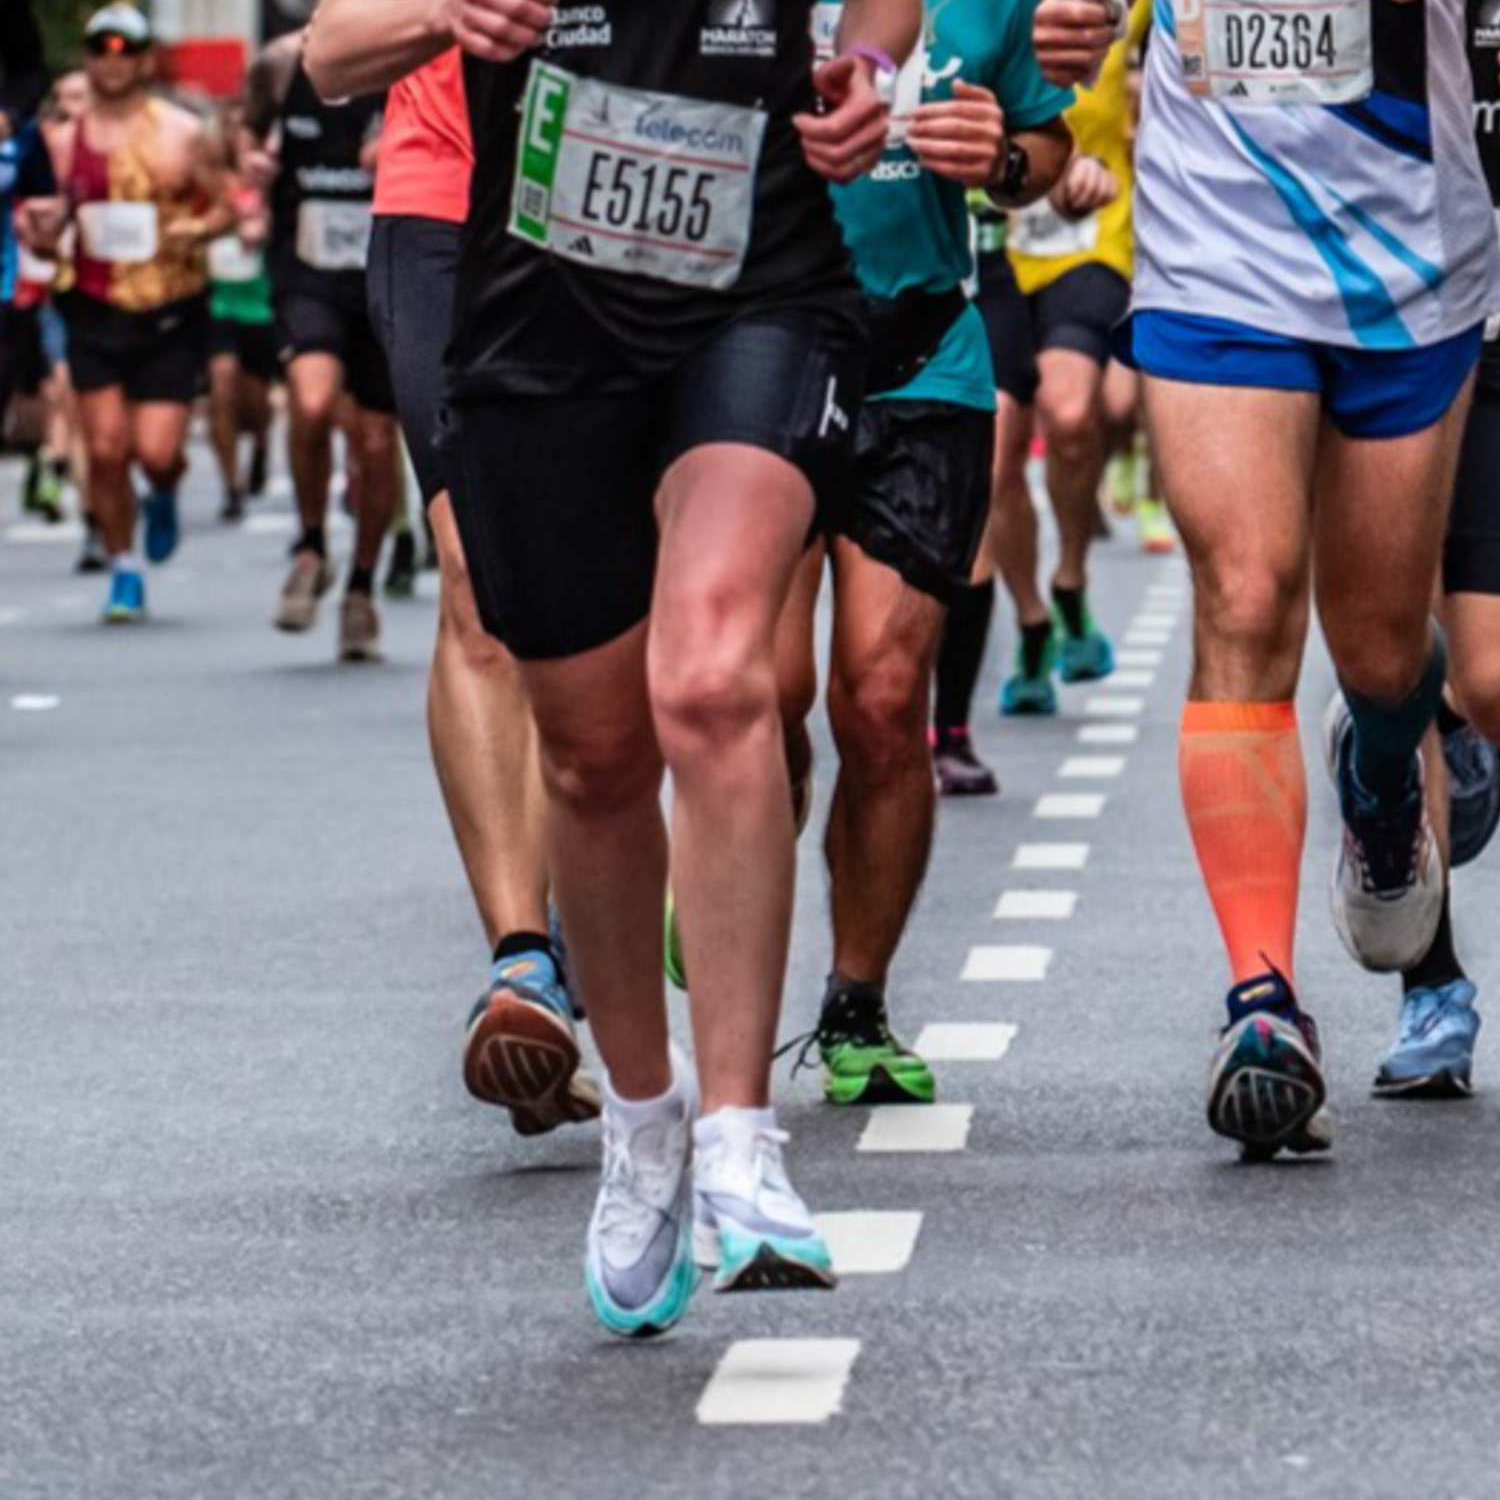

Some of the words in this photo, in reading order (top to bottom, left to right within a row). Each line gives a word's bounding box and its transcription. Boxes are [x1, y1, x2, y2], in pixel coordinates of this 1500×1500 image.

[545, 22, 613, 48] Ciudad
[1225, 12, 1337, 70] D2364
[528, 75, 564, 154] E
[634, 114, 744, 153] telecom
[580, 151, 716, 242] E5155
